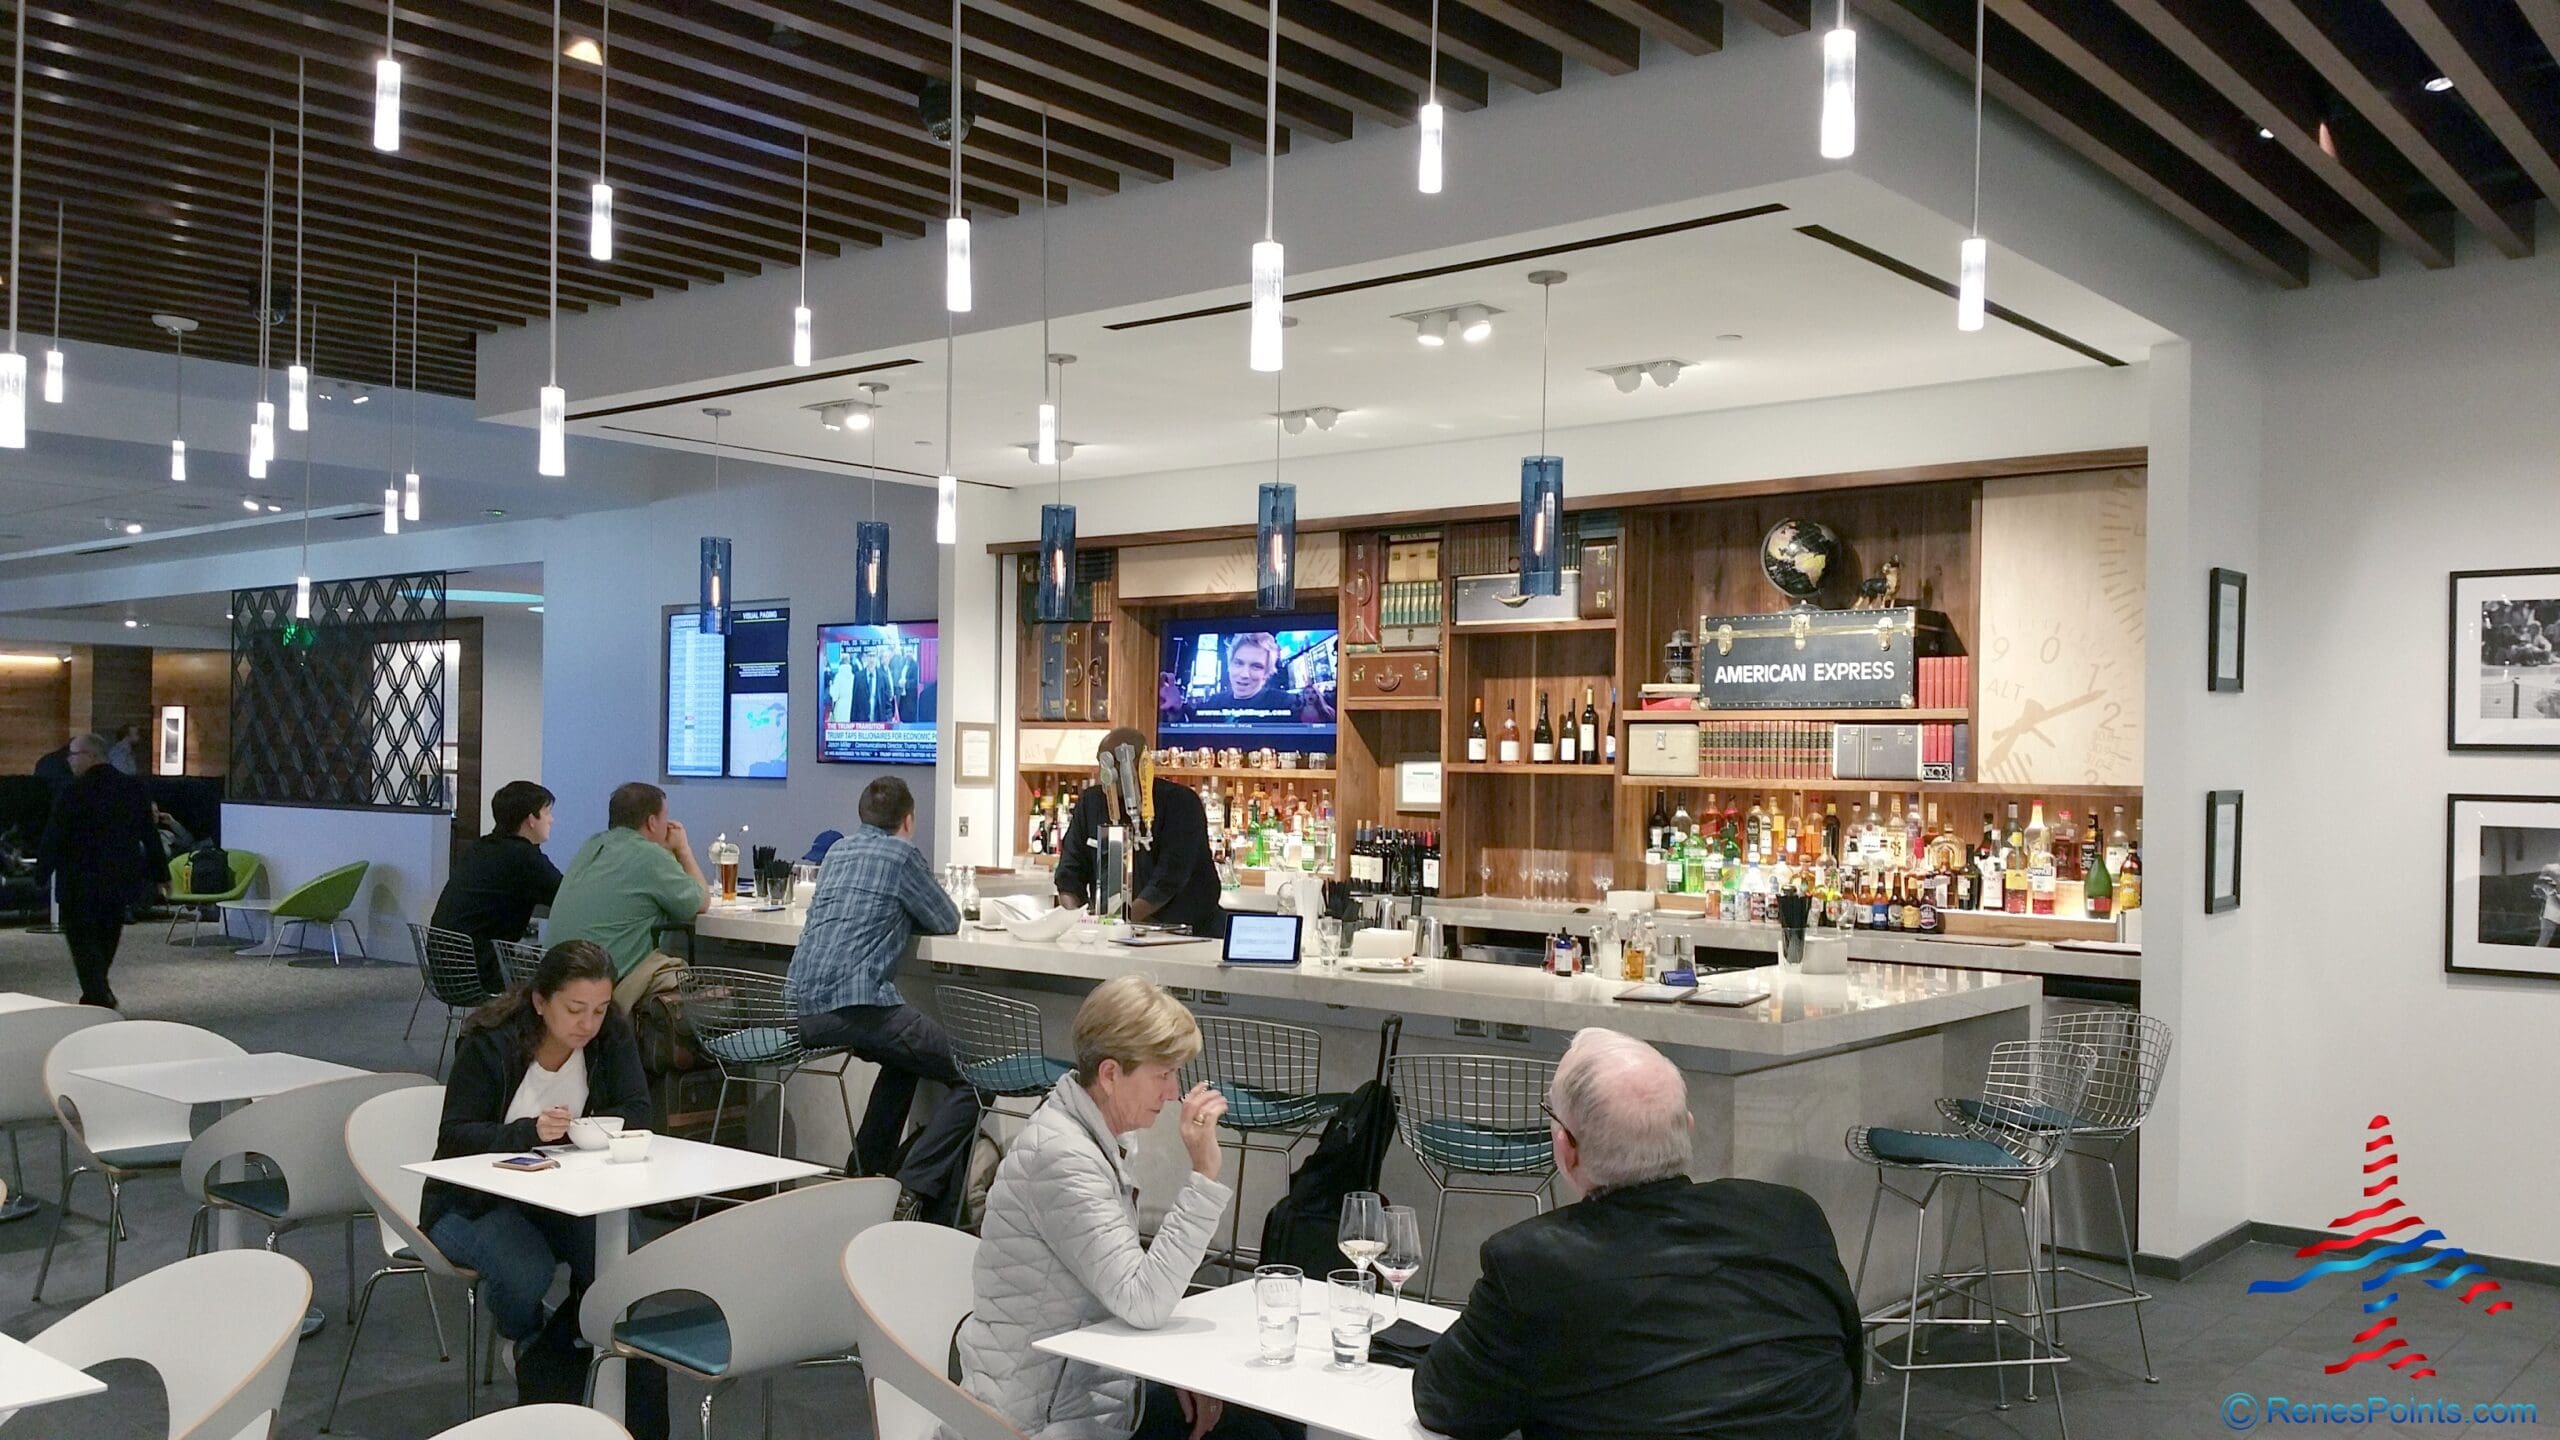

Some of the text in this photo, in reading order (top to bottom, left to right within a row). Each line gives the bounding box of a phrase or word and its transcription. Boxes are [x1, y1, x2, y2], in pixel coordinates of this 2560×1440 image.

[1992, 636, 2010, 663] 9
[1714, 660, 1895, 684] AMERICAN EXPRESS
[1986, 677, 2025, 702] ALT
[2098, 702, 2122, 731] 2
[827, 731, 845, 740] TRUMP
[845, 731, 857, 740] TAPS
[857, 731, 891, 740] BILLIONAIRES
[892, 732, 903, 740] FOR
[903, 732, 930, 741] ECONOMIC
